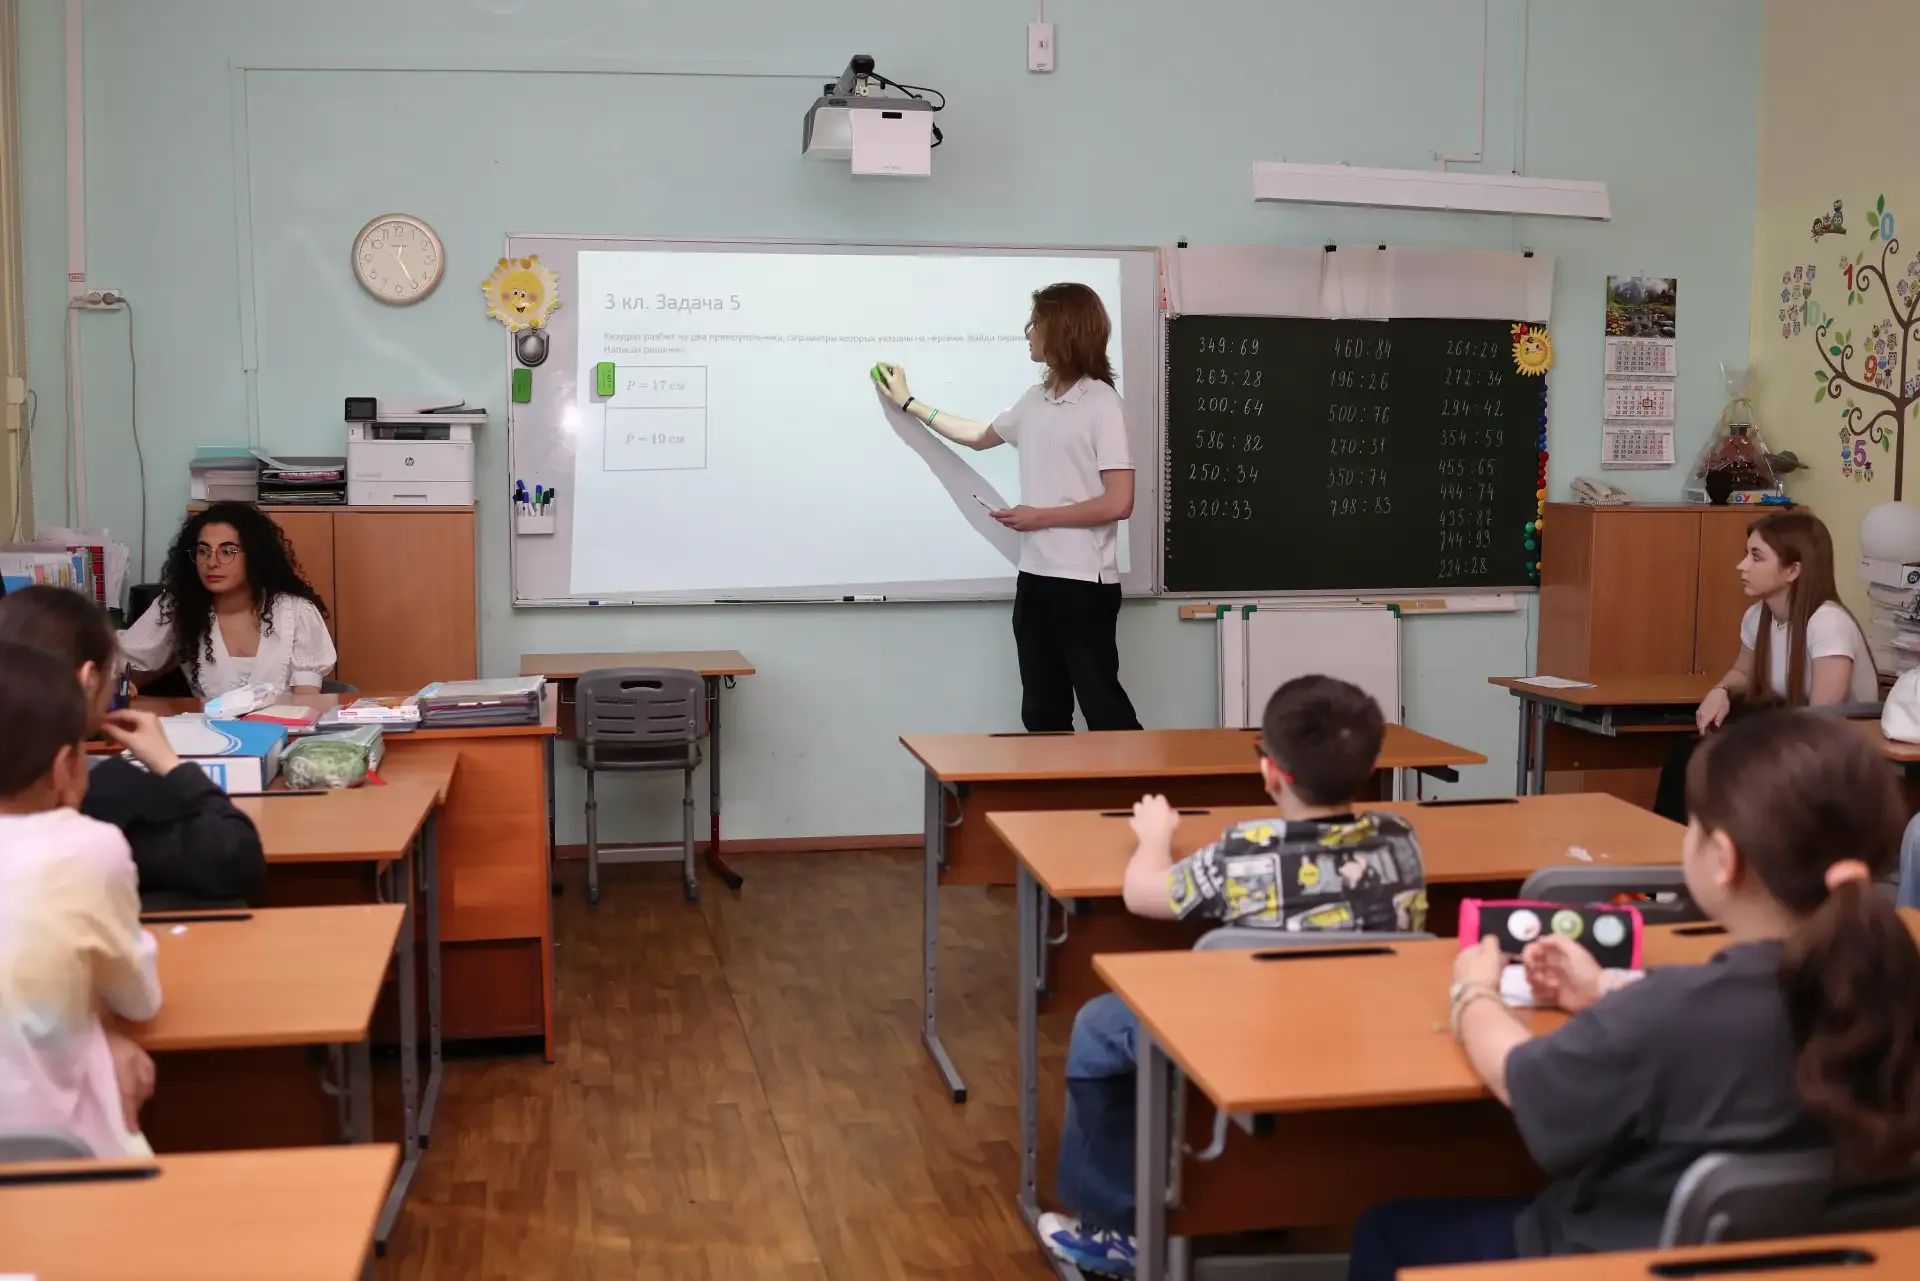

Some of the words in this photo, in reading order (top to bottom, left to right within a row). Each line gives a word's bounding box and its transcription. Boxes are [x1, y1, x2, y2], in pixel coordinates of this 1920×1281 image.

[393, 225, 403, 237] 12
[1880, 212, 1894, 241] 0
[370, 239, 383, 250] 10
[420, 240, 427, 251] 2
[364, 253, 373, 264] 9
[369, 268, 377, 280] 8
[1843, 264, 1853, 290] 1
[604, 293, 616, 310] 3
[622, 296, 650, 310] кл.
[656, 293, 723, 314] Задача
[730, 294, 741, 311] 5
[1799, 300, 1821, 326] 10
[1863, 355, 1878, 382] 9
[652, 380, 667, 391] 17
[1853, 439, 1867, 467] 5
